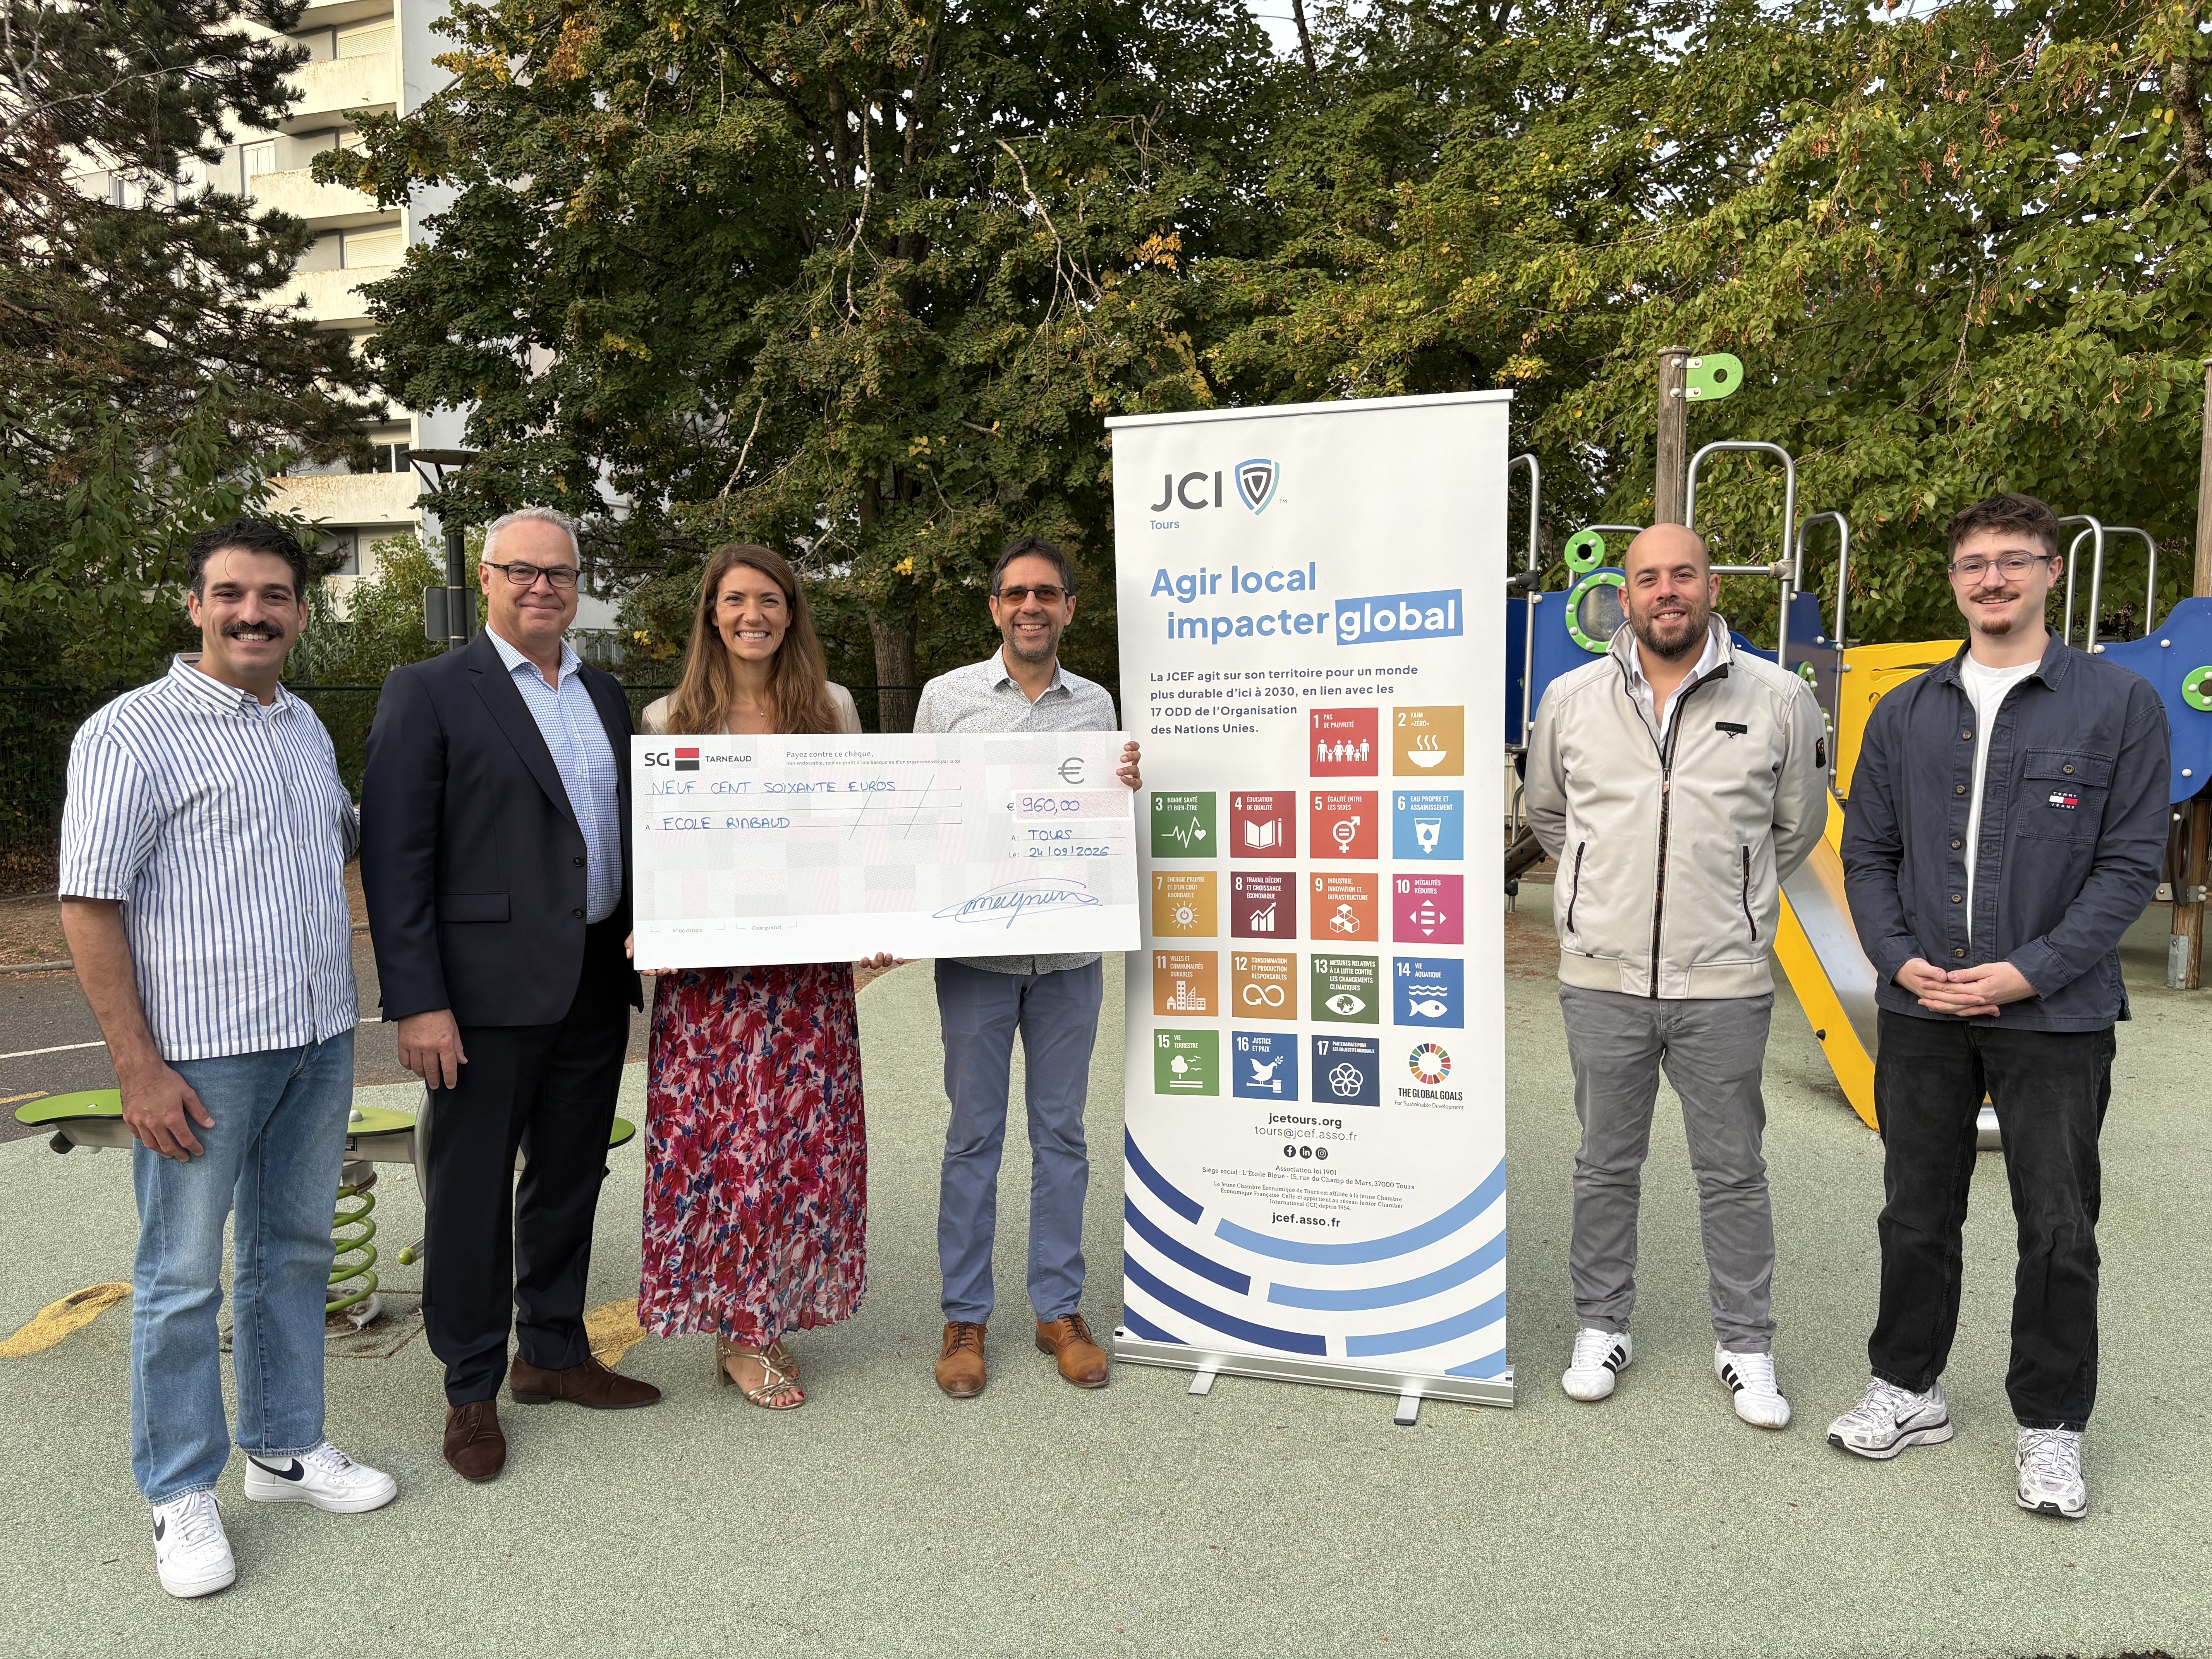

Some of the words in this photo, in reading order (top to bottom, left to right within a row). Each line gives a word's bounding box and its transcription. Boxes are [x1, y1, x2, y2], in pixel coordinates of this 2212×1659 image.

[1150, 471, 1222, 512] JCI
[1150, 520, 1180, 530] Tours
[1150, 567, 1221, 603] Agir
[1232, 562, 1316, 594] local
[1167, 610, 1329, 644] impacter
[1339, 599, 1455, 641] global
[1151, 673, 1163, 682] La
[1167, 672, 1194, 681] JCEF
[1197, 671, 1220, 682] agit
[1268, 668, 1322, 678] territoire
[1326, 669, 1354, 679] pour
[1376, 665, 1418, 675] monde
[1151, 690, 1175, 701] plus
[1178, 689, 1223, 699] durable
[1255, 687, 1261, 697] à
[1265, 687, 1298, 697] 2030,
[1320, 686, 1341, 695] lien
[1377, 684, 1394, 694] les
[1151, 708, 1161, 716] 17
[1165, 707, 1191, 716] ODD
[1195, 706, 1209, 716] de
[1313, 714, 1319, 728] 1
[1398, 712, 1406, 726] 2
[1151, 725, 1171, 734] des
[1175, 725, 1219, 734] Nations
[1223, 724, 1258, 733] Unies.
[644, 752, 670, 766] SG
[1058, 757, 1084, 784] €
[653, 780, 696, 795] NEUF
[711, 781, 751, 793] CENT
[848, 781, 895, 792] EUROS
[1022, 797, 1080, 816] 960,00
[1155, 797, 1163, 811] 3
[1234, 797, 1242, 811] 4
[1254, 803, 1273, 811] QUALITÉ
[1315, 797, 1322, 810] 5
[1398, 796, 1406, 810] 6
[663, 817, 711, 830] ECOLE
[1028, 830, 1072, 841] TOURS
[1156, 877, 1163, 890] 7
[1235, 877, 1243, 890] 8
[1315, 878, 1323, 892] 9
[1396, 879, 1410, 893] 10
[1247, 891, 1276, 899] ÉCONOMIQUE
[1156, 955, 1166, 969] 11
[1235, 957, 1247, 970] 12
[1314, 959, 1328, 973] 13
[1330, 966, 1333, 974] À
[1396, 962, 1410, 977] 14
[1157, 1034, 1170, 1048] 15
[1237, 1037, 1249, 1051] 16
[1317, 1040, 1329, 1055] 17
[1398, 1088, 1411, 1097] THE
[1412, 1089, 1439, 1099] GLOBAL
[1440, 1091, 1463, 1101] GOALS
[1268, 1113, 1342, 1129] jcetours.org
[1255, 1126, 1357, 1141] tours@jcef.asso.fr
[1276, 1165, 1312, 1173] Association
[1321, 1176, 1344, 1185] Champ
[1272, 1212, 1340, 1228] jcef.asso.fr
